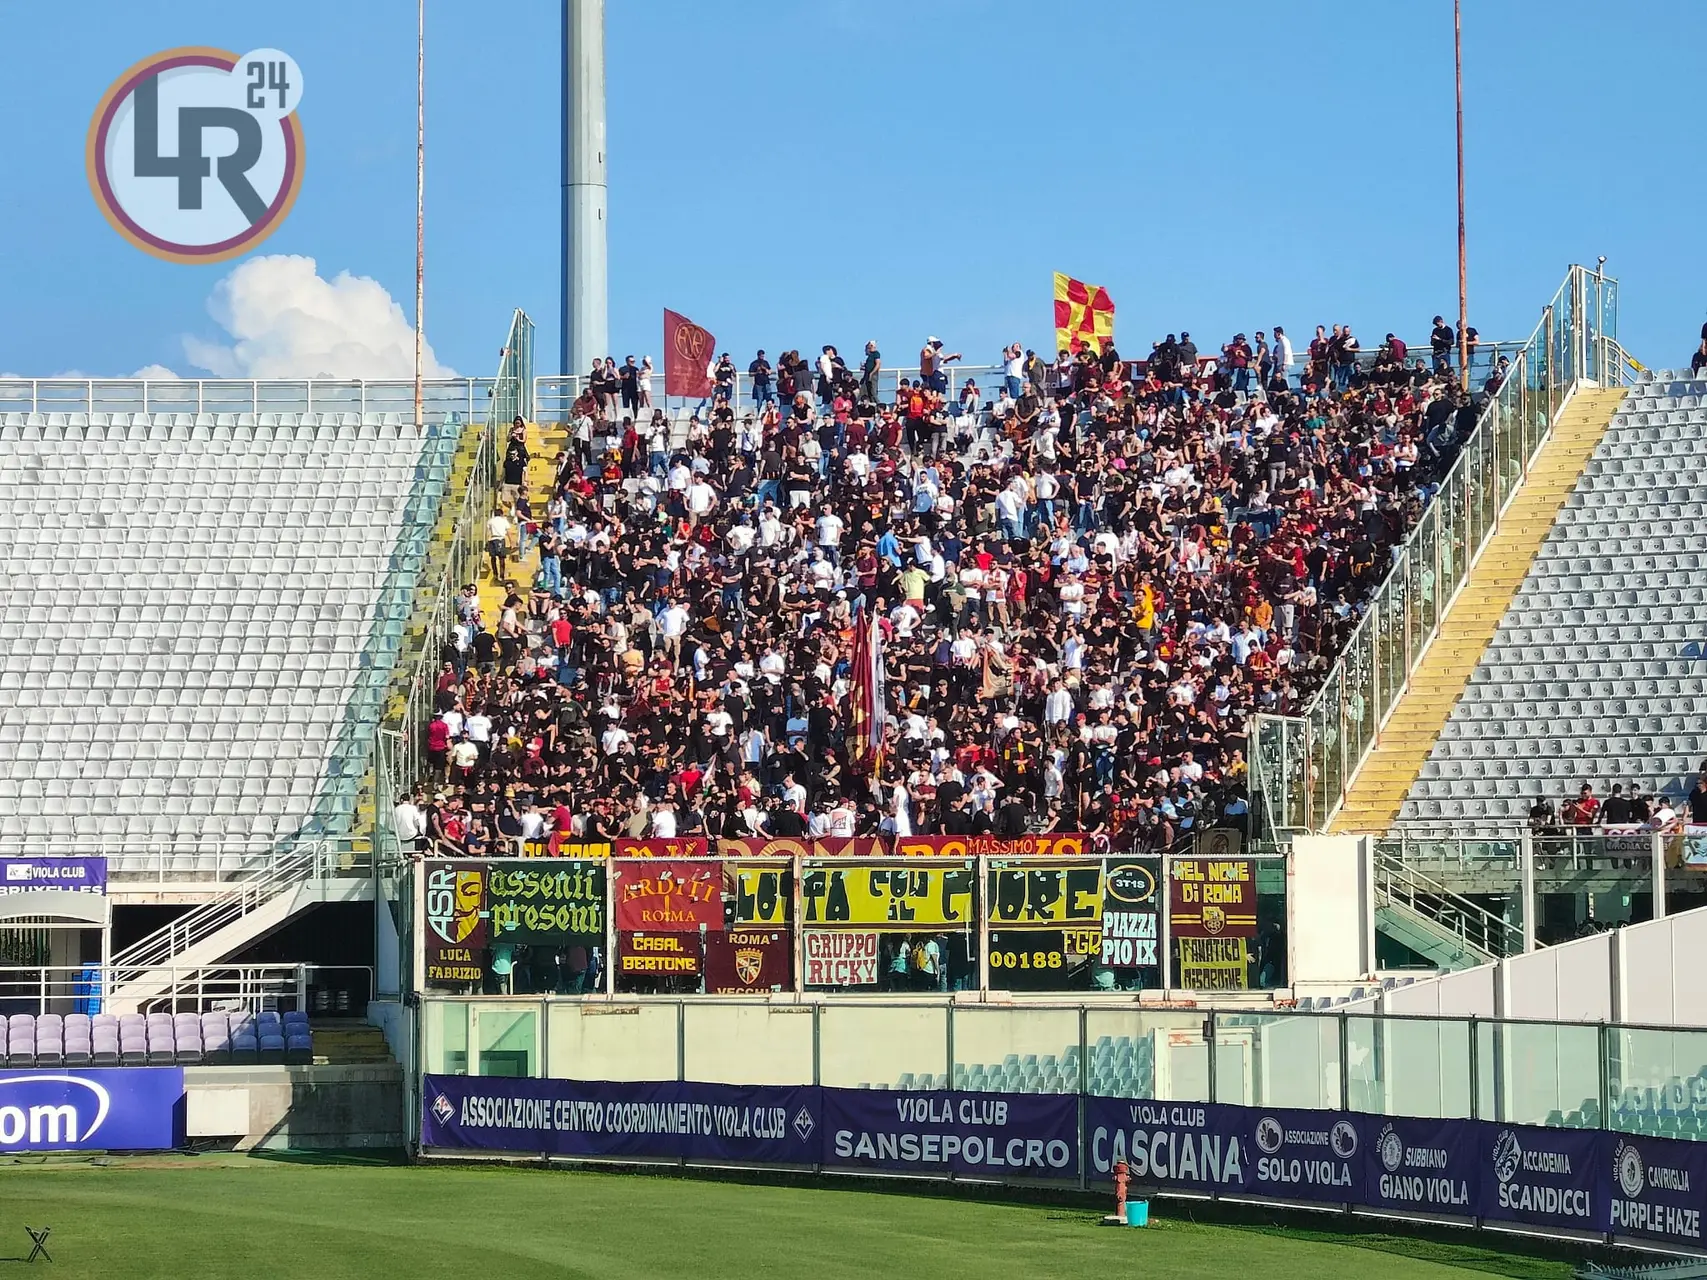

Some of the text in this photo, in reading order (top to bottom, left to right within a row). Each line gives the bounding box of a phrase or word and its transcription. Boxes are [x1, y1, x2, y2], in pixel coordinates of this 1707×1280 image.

[968, 839, 1033, 854] MASSIMO
[33, 866, 85, 878] VIOLA CLUB
[1208, 862, 1250, 882] NOME
[489, 870, 596, 901] assenti
[622, 878, 716, 904] ARDITI
[1203, 884, 1243, 903] ROMA
[427, 868, 458, 944] ASR
[642, 909, 696, 922] ROMA
[1103, 911, 1157, 938] PIAZZA
[632, 937, 684, 951] CASAL
[729, 933, 771, 945] ROMA
[807, 933, 877, 958] GRUPPO
[440, 949, 472, 962] LUCA
[622, 956, 697, 971] BERTONE
[990, 951, 1062, 969] 00188
[1102, 940, 1158, 965] PIO IX
[428, 966, 481, 980] FABRIZIO
[809, 959, 876, 984] RICKY
[460, 1096, 786, 1139] ASSOCIAZIONE CENTRO COORDINAMENTO VIOLA CLUB
[897, 1098, 1008, 1126] VIOLA CLUB
[1129, 1104, 1206, 1127] VIOLA CLUB
[834, 1130, 1070, 1168] SANSEPOLCRO
[1284, 1130, 1329, 1146] ASSOCIAZIONE
[1092, 1126, 1244, 1184] CASCIANA
[1405, 1147, 1447, 1169] SUBBIANO
[1523, 1150, 1572, 1174] ACCADEMIA
[1257, 1157, 1352, 1187] SOLO VIOLA
[1648, 1166, 1690, 1192] CAVRIGLIA
[1380, 1174, 1469, 1205] GIANO VIOLA
[1499, 1182, 1591, 1217] SCANDICCI
[1610, 1199, 1701, 1238] PURPLE HAZE
